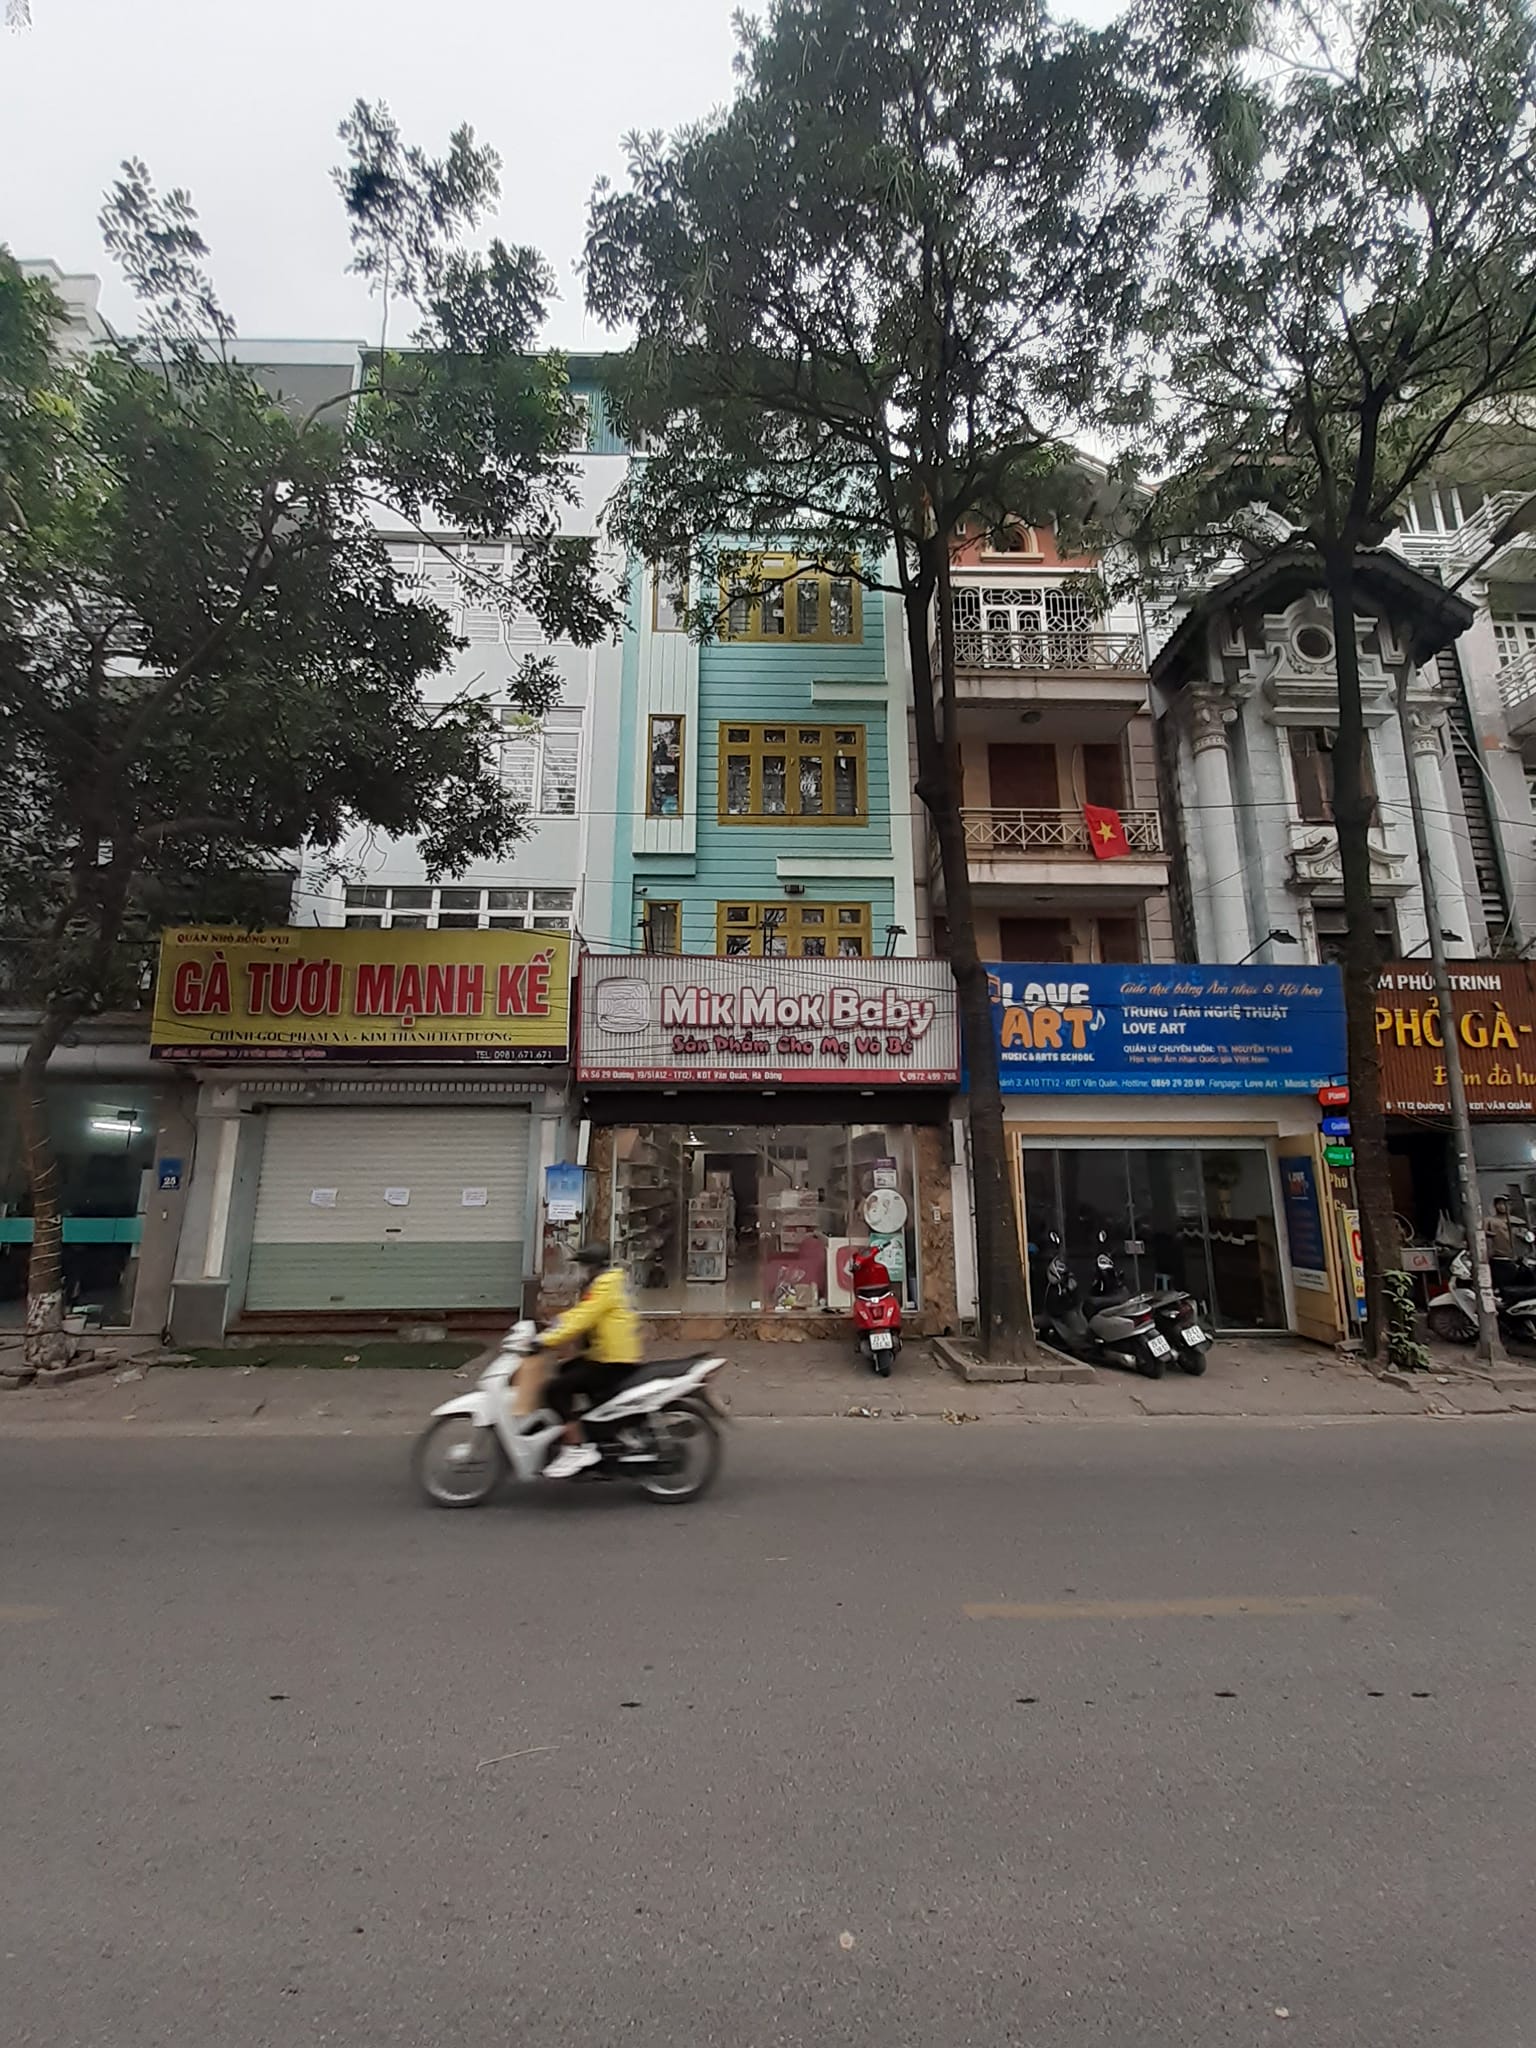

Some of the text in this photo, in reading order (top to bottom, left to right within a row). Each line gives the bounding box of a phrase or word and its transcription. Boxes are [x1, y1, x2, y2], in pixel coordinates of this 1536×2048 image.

[270, 935, 290, 945] VUI
[173, 947, 555, 1028] GÀ TƯƠI MẠNH KẾ
[1262, 984, 1274, 995] &
[1397, 970, 1437, 991] PHÚ
[1448, 974, 1502, 991] TRINH
[1002, 982, 1093, 1013] LOVE
[829, 986, 937, 1041] Baby
[1122, 1003, 1289, 1021] TRUNG TÂM NGHỆ THUẬT
[360, 1032, 387, 1042] KIM
[1001, 1007, 1094, 1049] ART
[1122, 1022, 1187, 1035] LOVE ART
[672, 1030, 914, 1063] Sản Phẩm Cho Mẹ Và Bé
[1060, 1052, 1096, 1062] SCHOOL
[1024, 1078, 1040, 1088] A10
[1244, 1078, 1263, 1088] Love
[1264, 1078, 1278, 1088] Art
[1284, 1078, 1309, 1089] Music
[1431, 1063, 1482, 1088] Đm
[1486, 1061, 1513, 1087] đà
